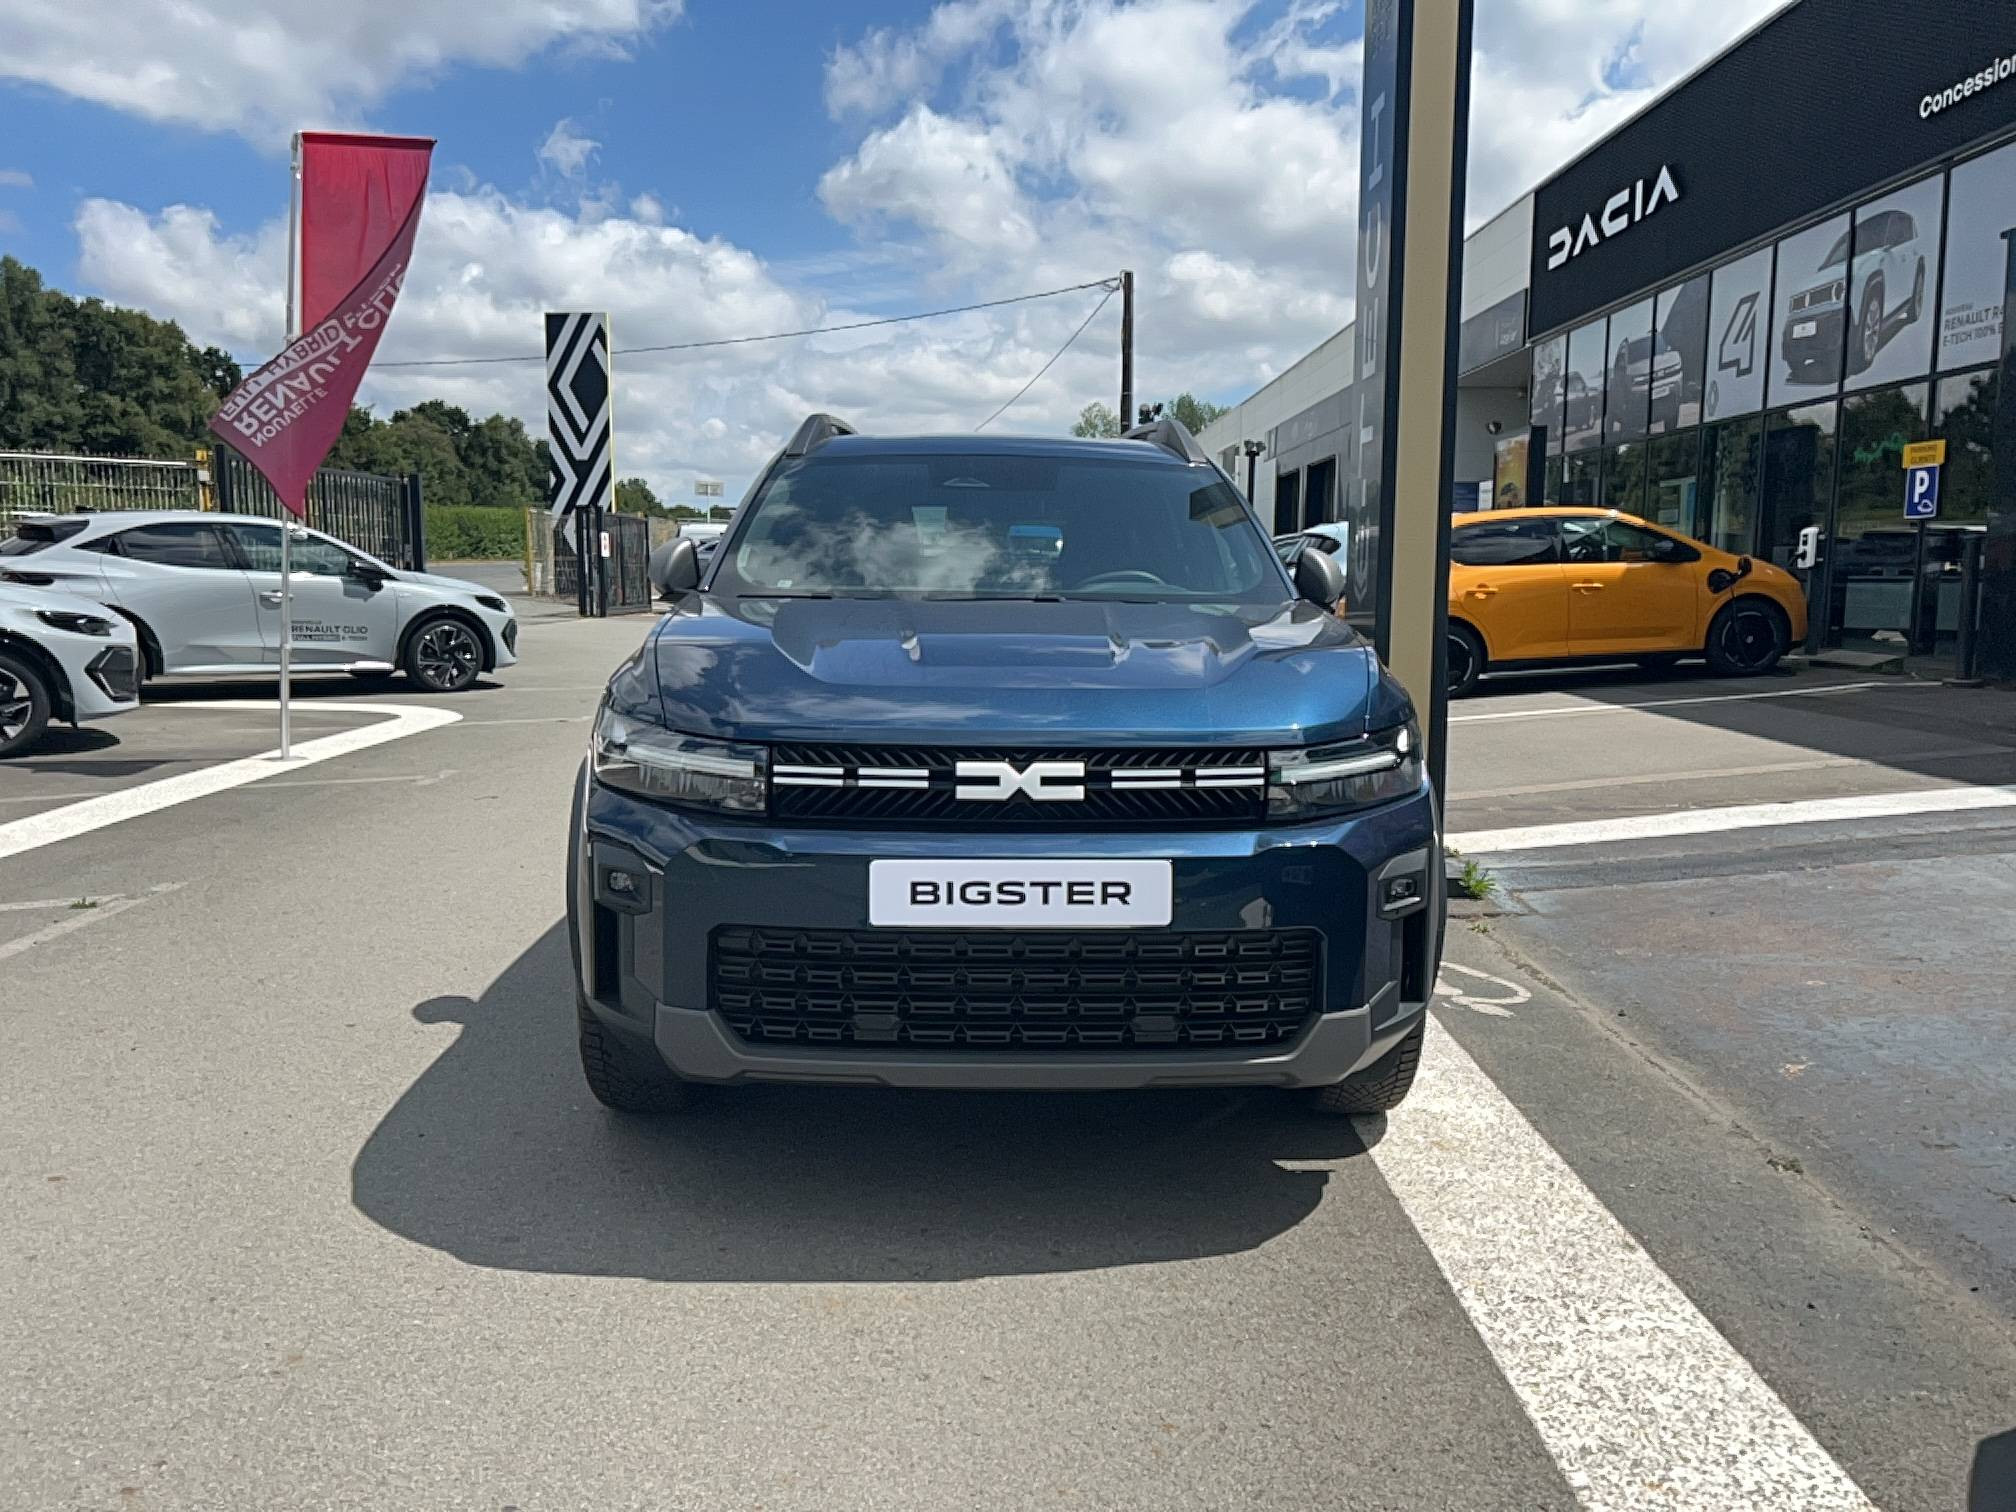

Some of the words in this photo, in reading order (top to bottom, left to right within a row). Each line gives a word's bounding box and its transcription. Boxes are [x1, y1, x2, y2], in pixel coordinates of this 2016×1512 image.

[1547, 164, 1680, 271] DACIA
[1913, 470, 1930, 503] P
[290, 624, 340, 633] RENAULT
[342, 625, 369, 634] CLIO
[909, 880, 1131, 905] BIGSTER
